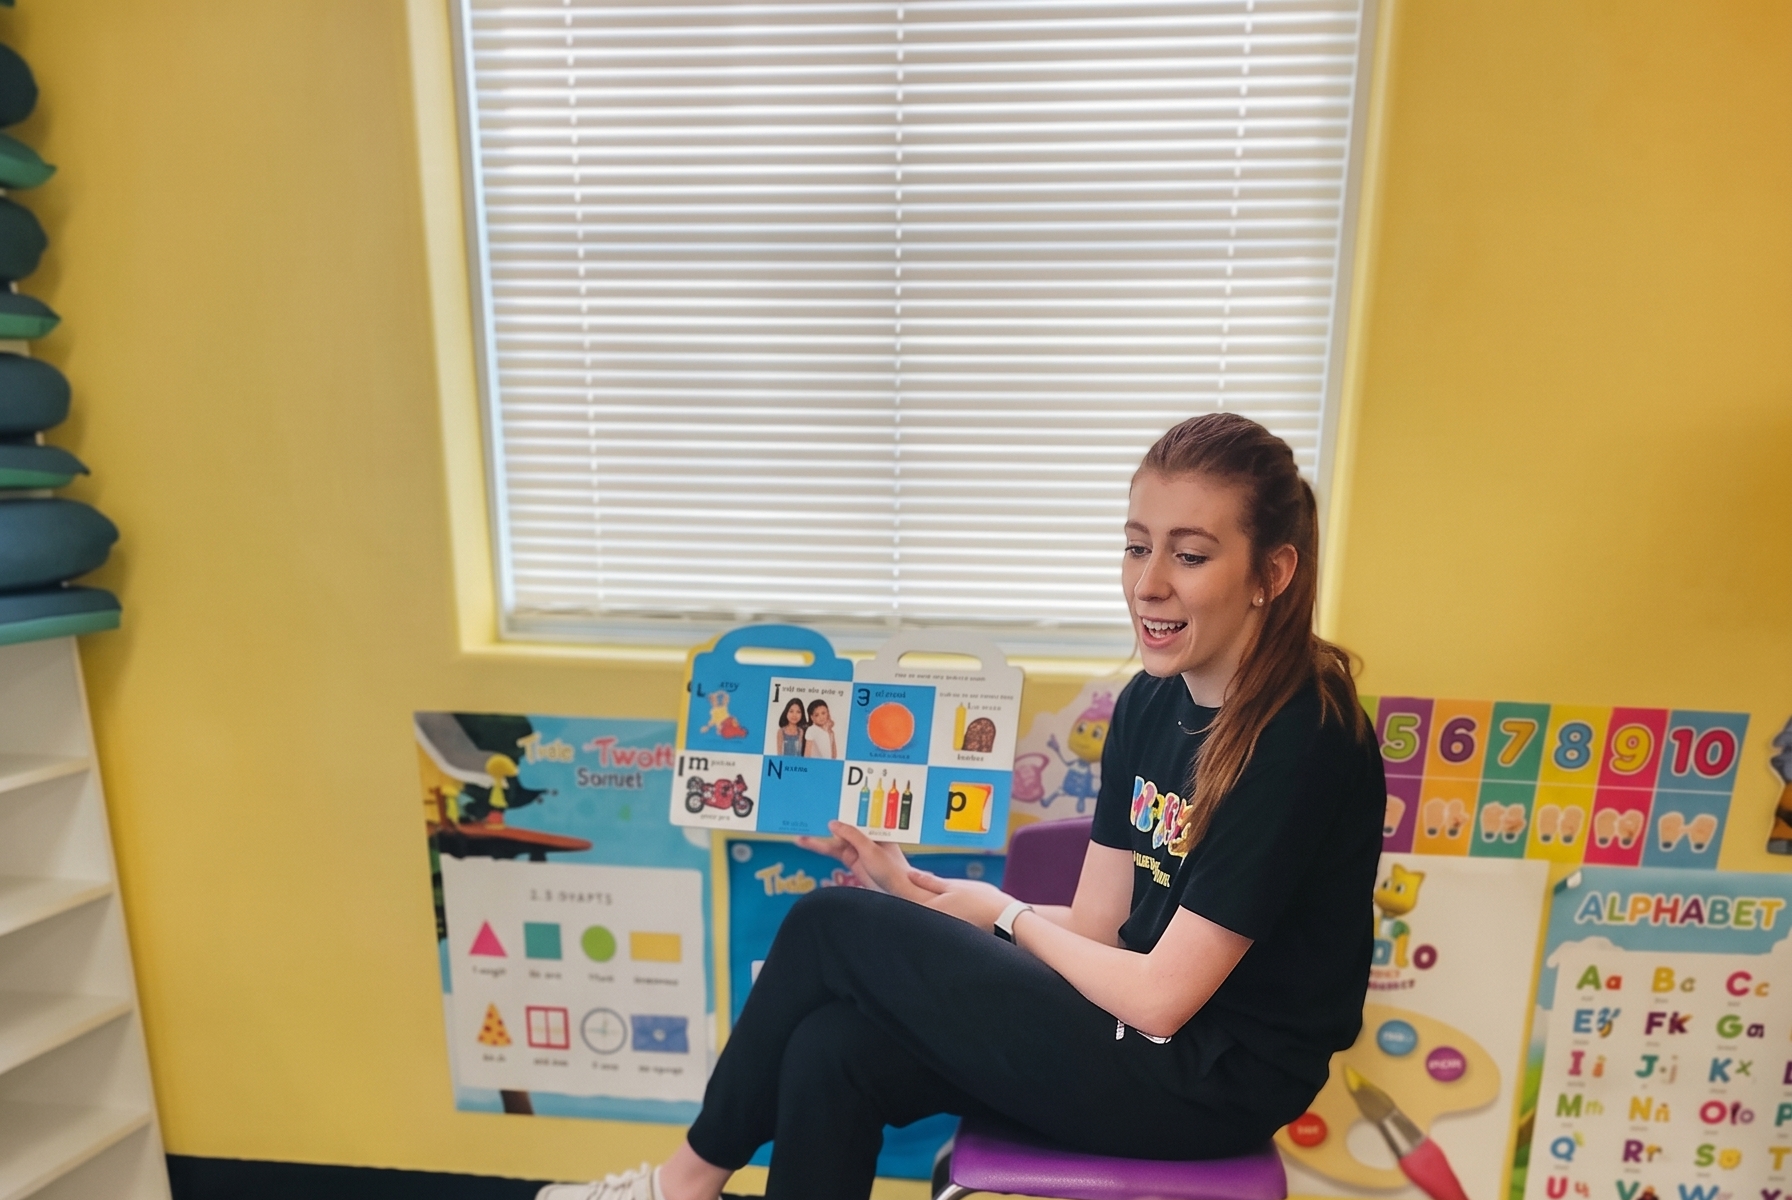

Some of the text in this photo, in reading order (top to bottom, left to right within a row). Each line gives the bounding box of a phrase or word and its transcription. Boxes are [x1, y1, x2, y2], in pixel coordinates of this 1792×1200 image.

[1381, 714, 1738, 778] 5 6 7 8 9 10
[847, 766, 864, 787] D
[1576, 892, 1785, 930] ALPHABET
[1576, 964, 1623, 991] Aa
